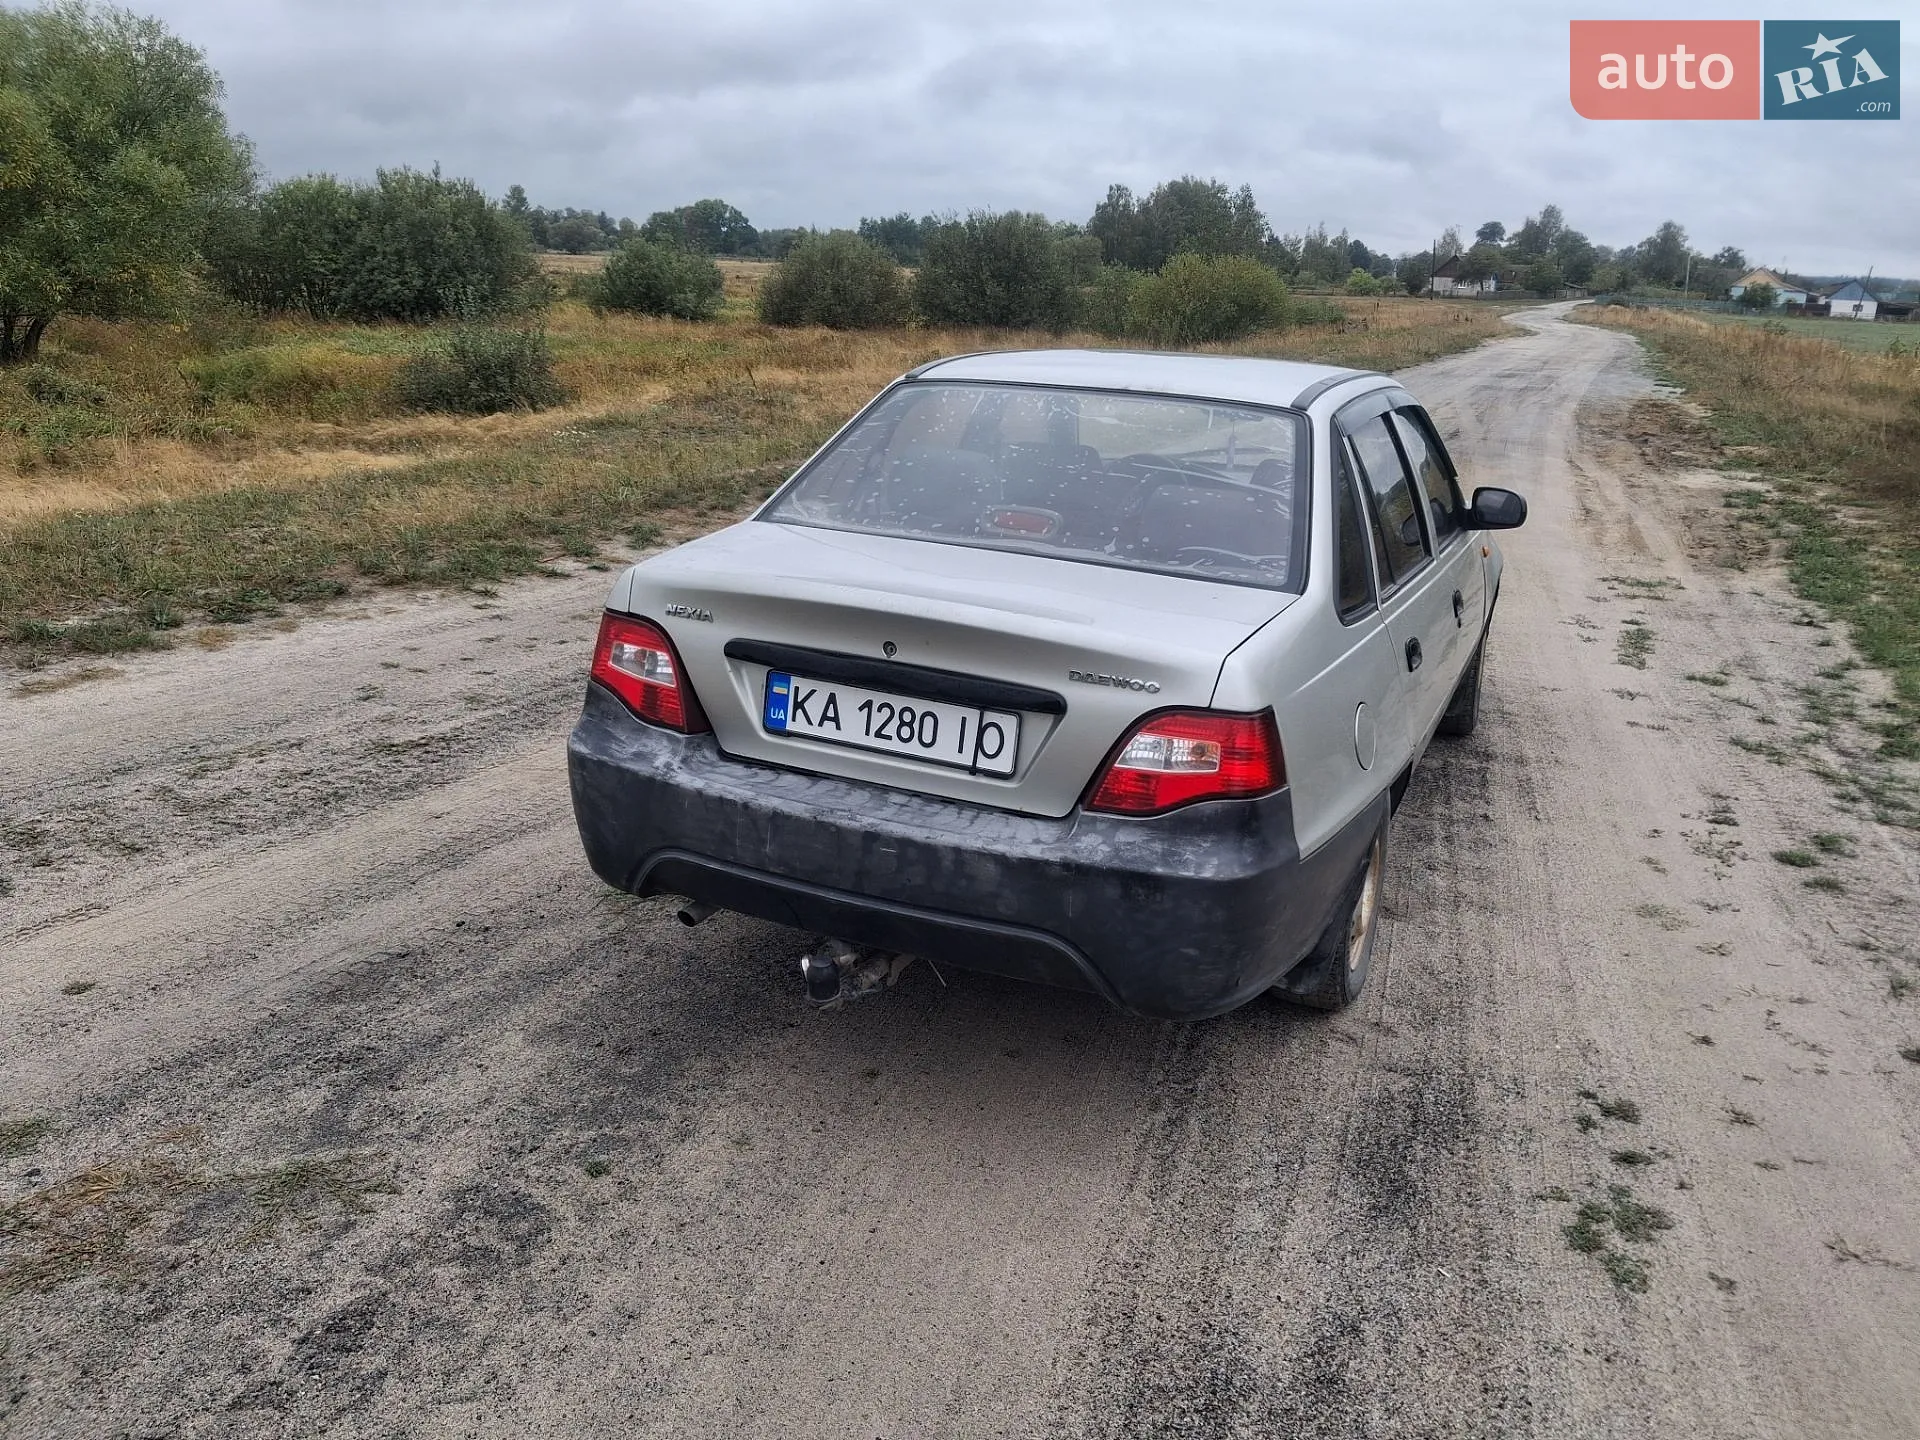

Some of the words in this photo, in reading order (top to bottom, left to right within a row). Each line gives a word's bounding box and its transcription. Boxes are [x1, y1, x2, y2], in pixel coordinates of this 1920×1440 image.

[665, 603, 714, 623] NEXIA
[1068, 669, 1161, 694] DAEWOO
[770, 708, 786, 721] UA
[790, 685, 842, 731] KA
[857, 699, 939, 748] 1280
